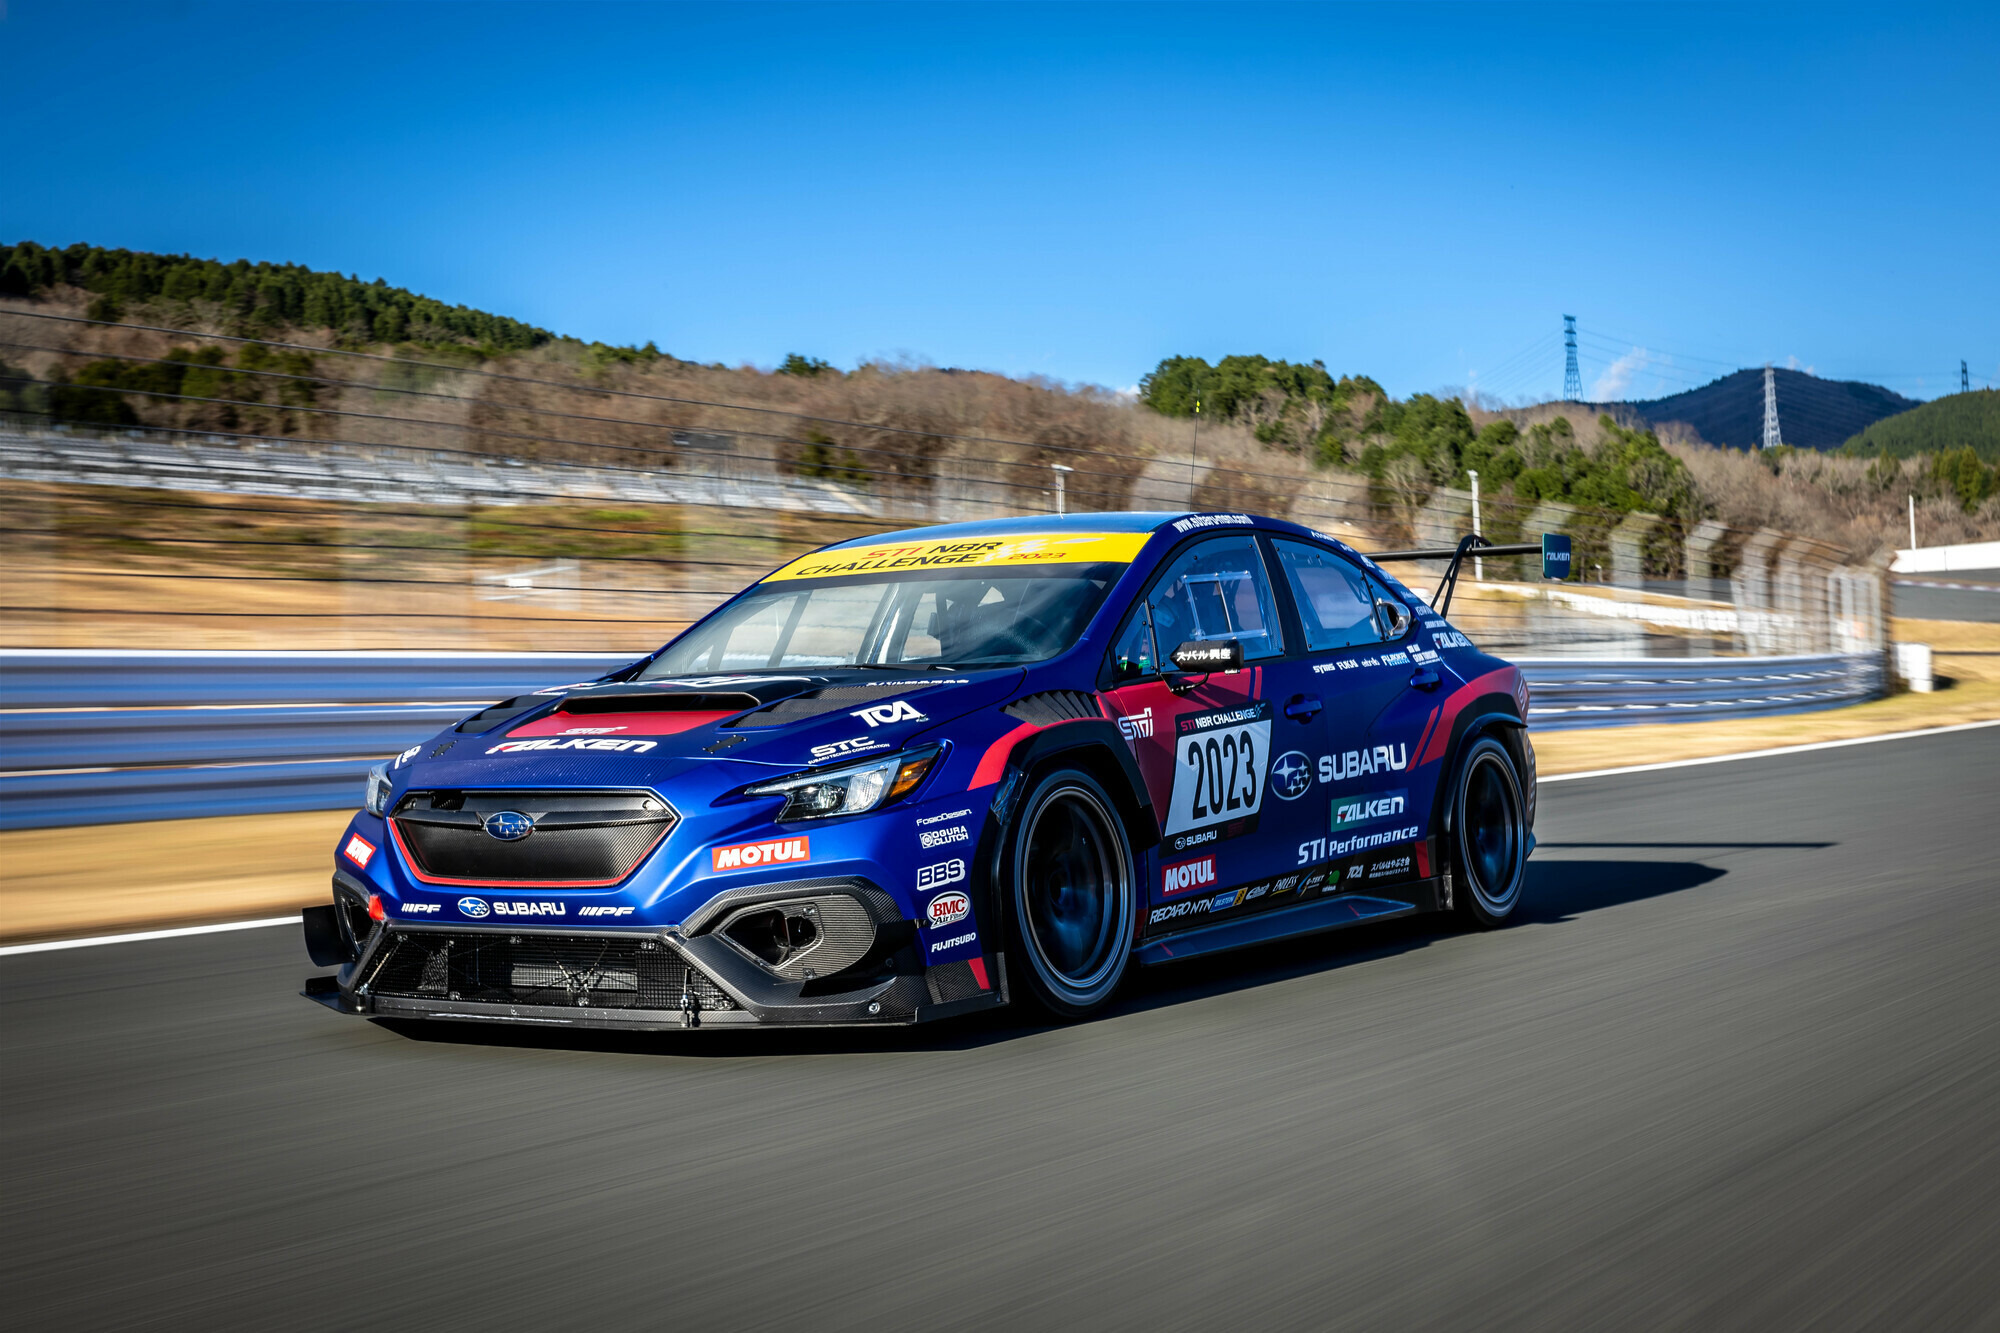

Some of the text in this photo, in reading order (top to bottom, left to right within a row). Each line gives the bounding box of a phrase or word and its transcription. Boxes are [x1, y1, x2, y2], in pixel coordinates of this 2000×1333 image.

[862, 542, 1003, 560] STI NBR
[1008, 552, 1066, 560] 2023
[1546, 552, 1570, 562] FALKEN
[796, 553, 985, 575] CHALLENGE
[1181, 708, 1256, 732] STI NBR CHALLENGE
[485, 739, 658, 754] FALKEN
[808, 755, 829, 765] SUBARU
[852, 743, 890, 753] CORPORATION
[811, 736, 875, 757] STC
[1318, 743, 1407, 784] SUBARU
[1188, 730, 1257, 820] 2023
[1336, 796, 1404, 824] FALKEN
[932, 826, 967, 838] OGURA
[934, 833, 969, 846] CLUTCH
[1186, 830, 1217, 846] SUBARU
[717, 840, 806, 869] MOTUL
[1298, 826, 1419, 865] STI Performance
[917, 858, 966, 891] BBS
[1164, 859, 1215, 893] MOTUL
[493, 902, 566, 916] SUBARU
[933, 899, 965, 917] BMC
[1149, 901, 1191, 925] RECARO
[1190, 898, 1214, 915] NTN
[934, 916, 949, 925] Air
[931, 932, 976, 953] FUJITSUBO
